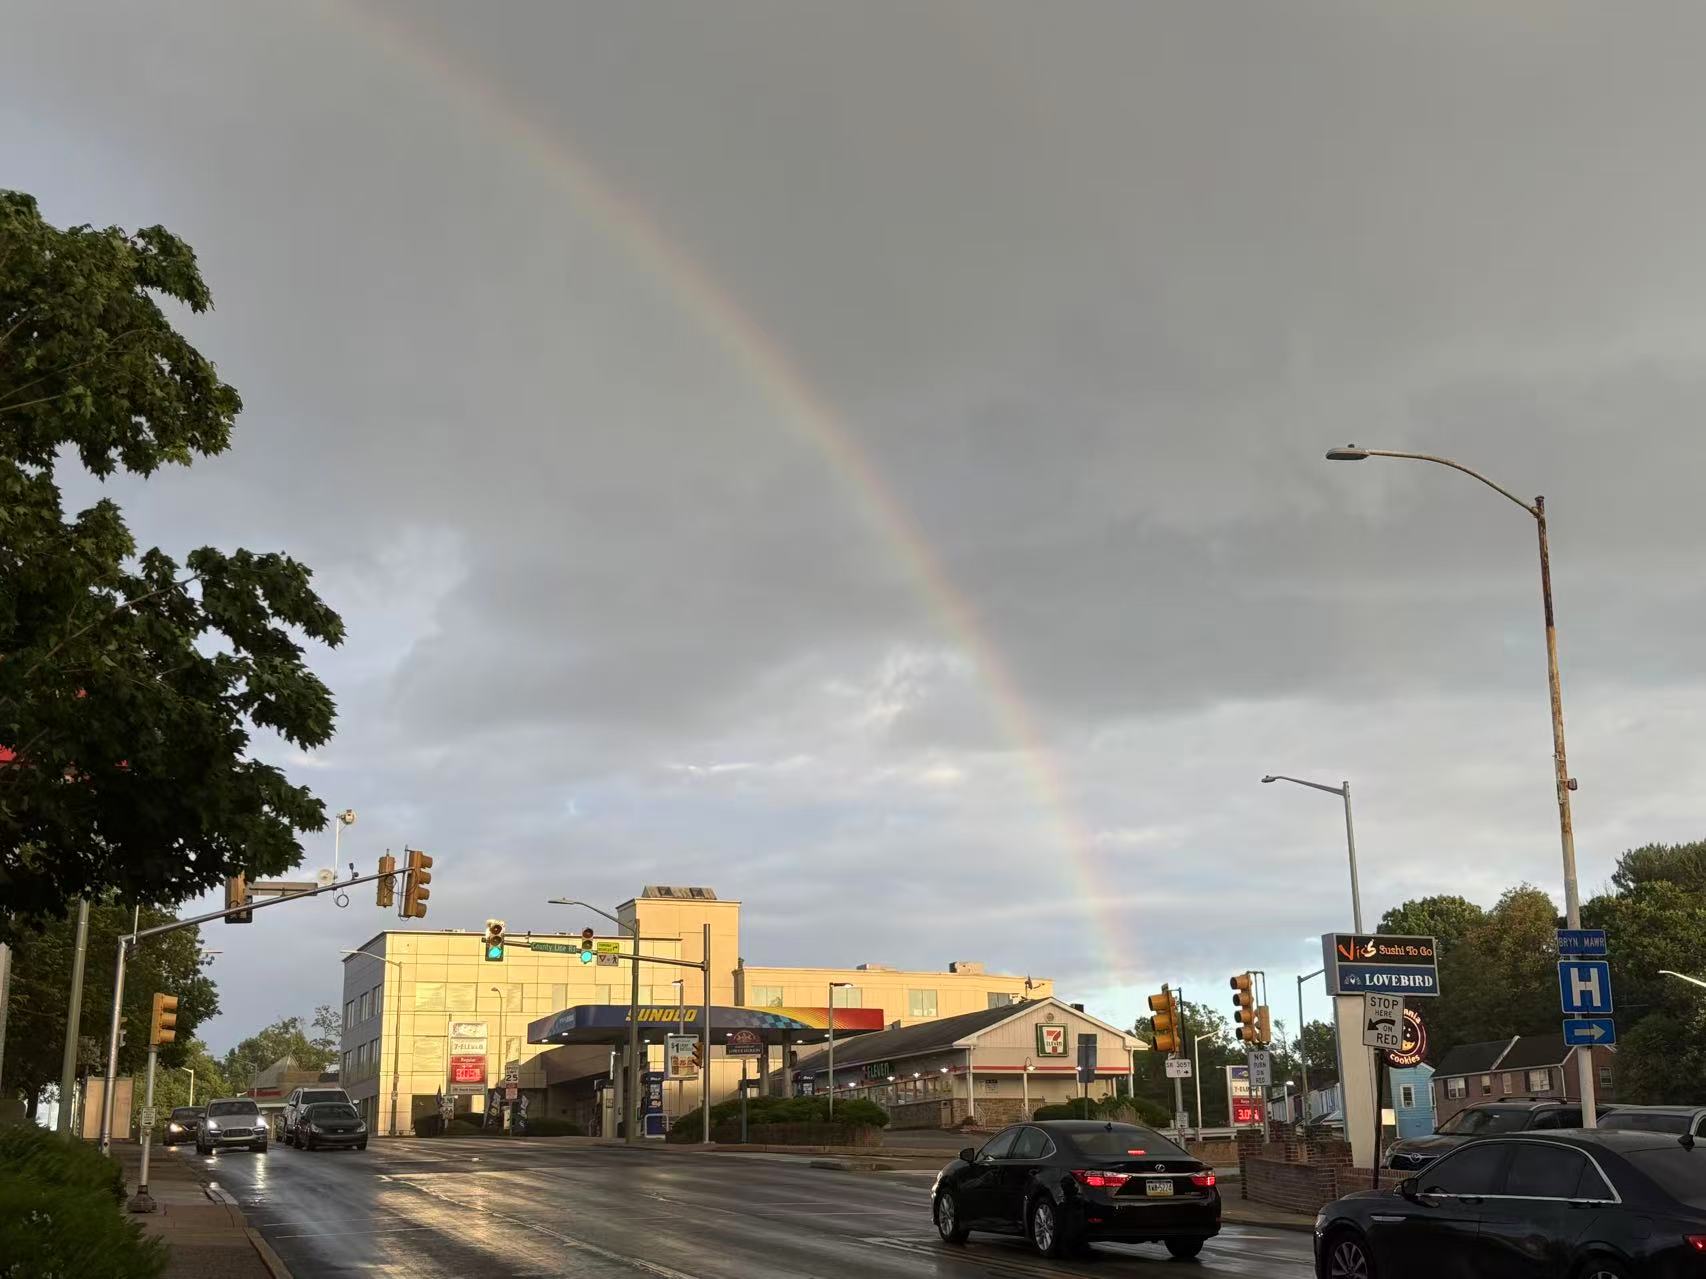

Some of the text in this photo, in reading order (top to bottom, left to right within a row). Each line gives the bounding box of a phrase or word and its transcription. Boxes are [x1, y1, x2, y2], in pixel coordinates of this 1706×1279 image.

[532, 943, 552, 952] County
[1558, 937, 1604, 947] BRYN MAWR
[1379, 944, 1405, 955] Sushi
[1406, 945, 1418, 956] To
[1420, 946, 1433, 956] Go
[1365, 973, 1434, 987] LOVEBIRD
[1570, 967, 1601, 1007] H
[1370, 996, 1399, 1010] STOP
[1374, 1009, 1393, 1018] HERE
[1046, 1029, 1062, 1053] 7
[1376, 1032, 1399, 1045] RED
[1253, 1053, 1265, 1061] NO
[1389, 1052, 1421, 1065] cookies
[505, 1074, 519, 1082] 25
